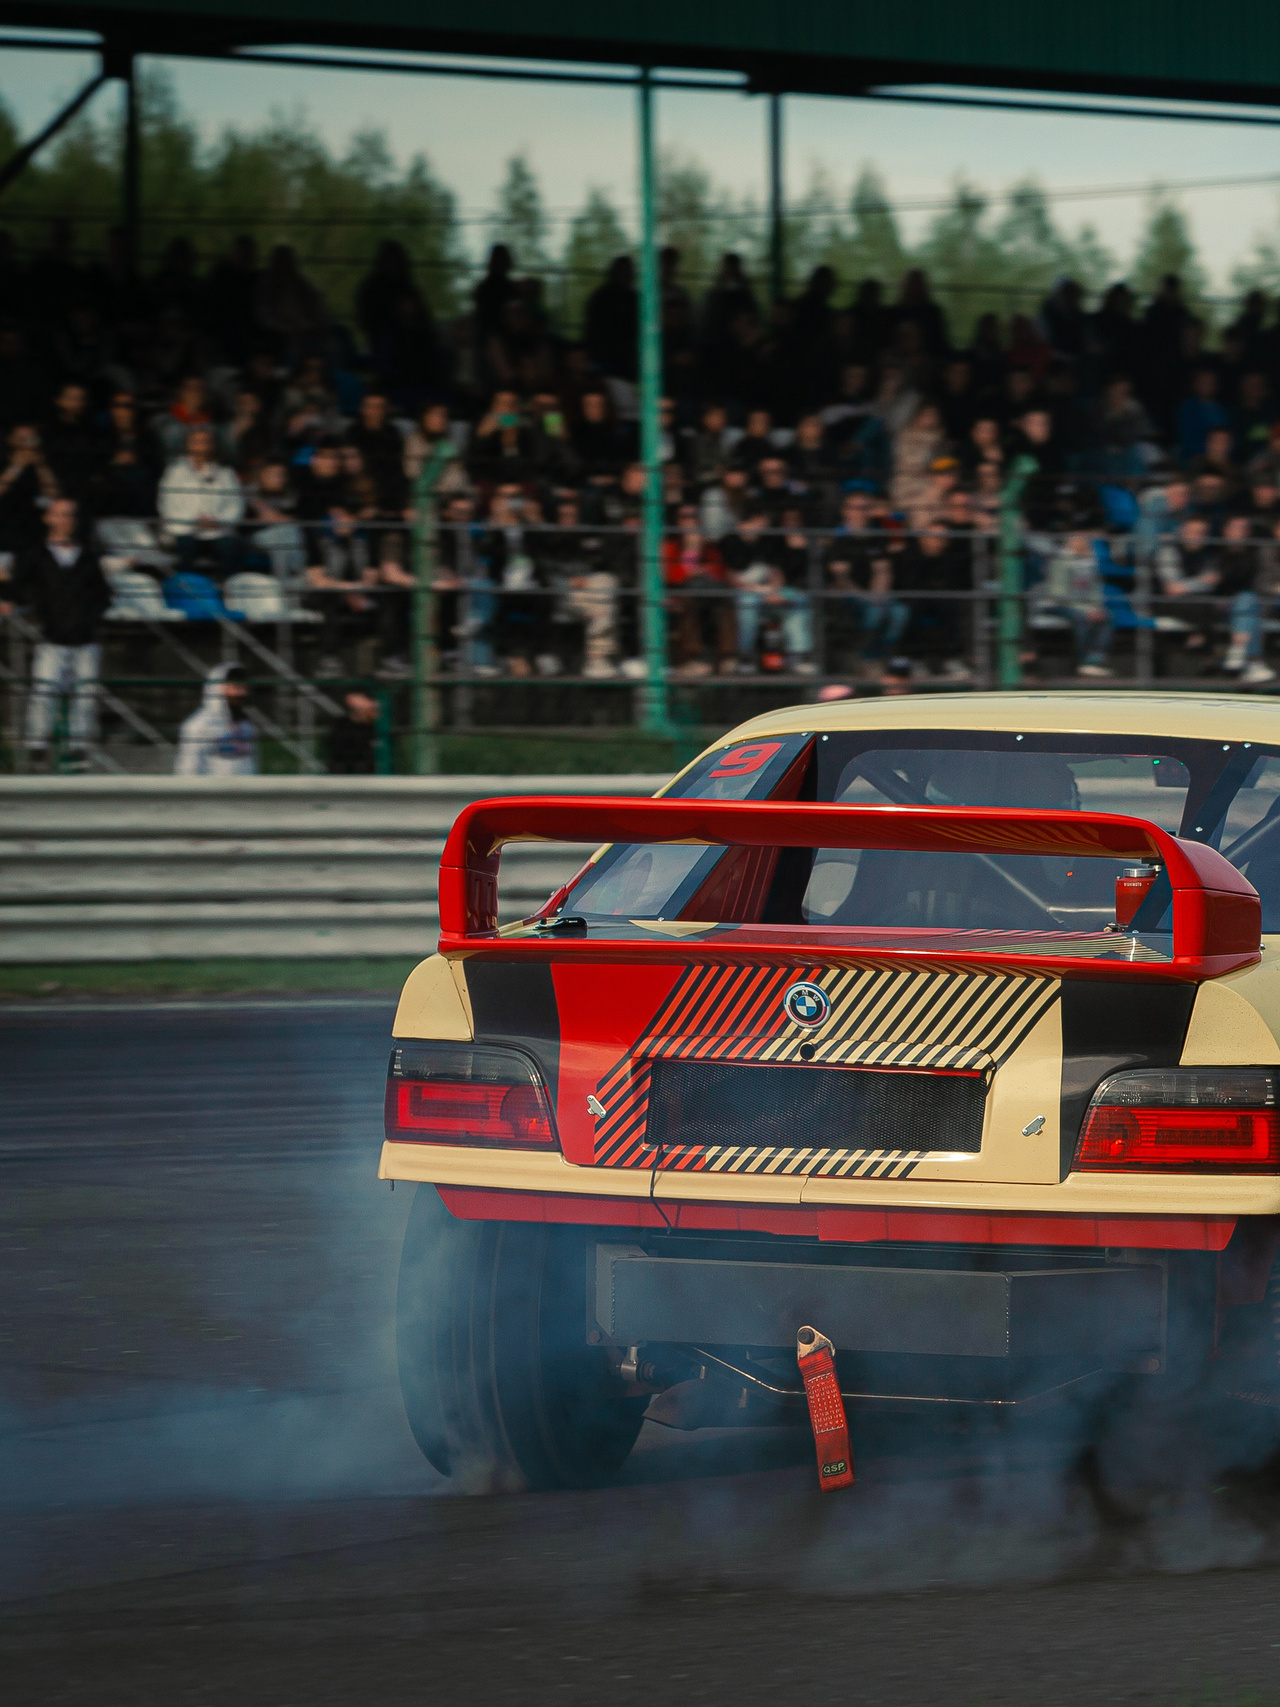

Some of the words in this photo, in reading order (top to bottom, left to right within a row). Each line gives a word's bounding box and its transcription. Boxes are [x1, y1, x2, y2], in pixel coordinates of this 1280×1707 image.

[708, 742, 782, 778] 9
[792, 989, 820, 1002] BMW
[823, 1462, 845, 1474] QSP
